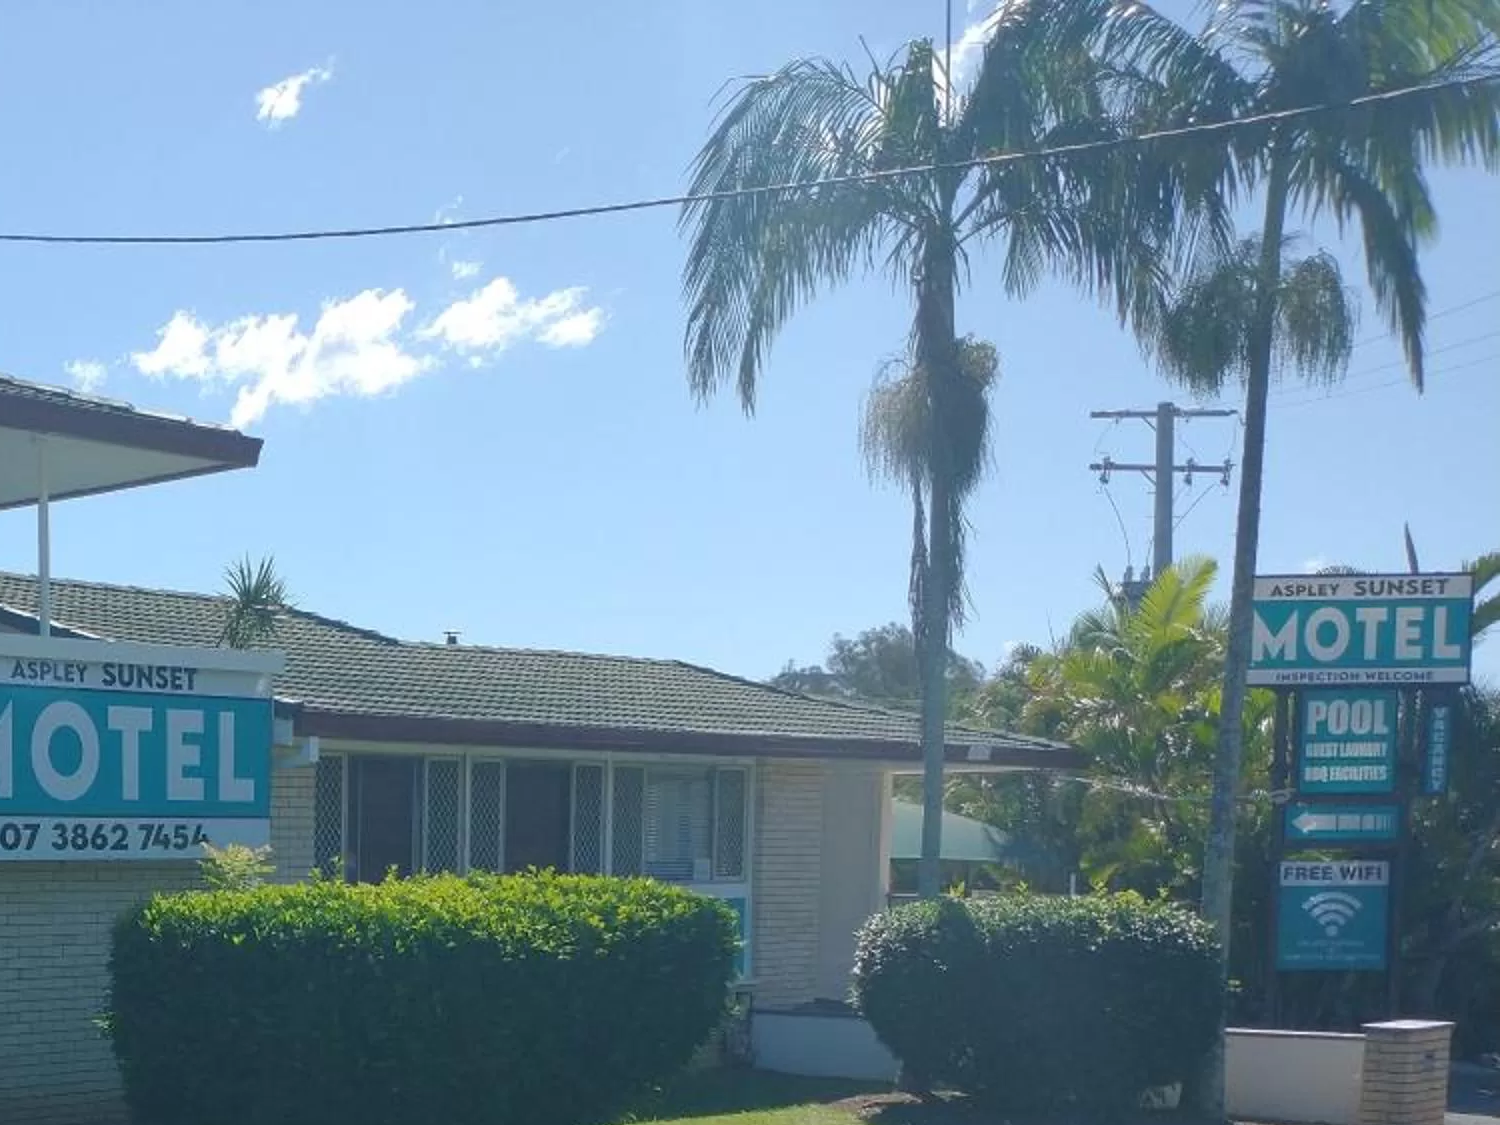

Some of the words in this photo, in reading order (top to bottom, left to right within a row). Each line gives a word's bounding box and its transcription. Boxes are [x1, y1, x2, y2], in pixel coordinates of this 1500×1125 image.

[1271, 584, 1340, 597] ASPLEY
[1353, 579, 1449, 596] SUNSET
[1252, 607, 1461, 661] MOTEL
[11, 659, 88, 683] ASPLEY
[102, 663, 197, 691] SUNSET
[1276, 671, 1360, 682] INSPECTION
[1365, 671, 1434, 682] WELCOME
[1307, 700, 1389, 734] POOL
[0, 823, 40, 850] 07
[51, 823, 128, 851] 3862
[138, 823, 209, 851] 7454
[1283, 866, 1333, 881] FREE
[1339, 866, 1382, 881] WIFI
